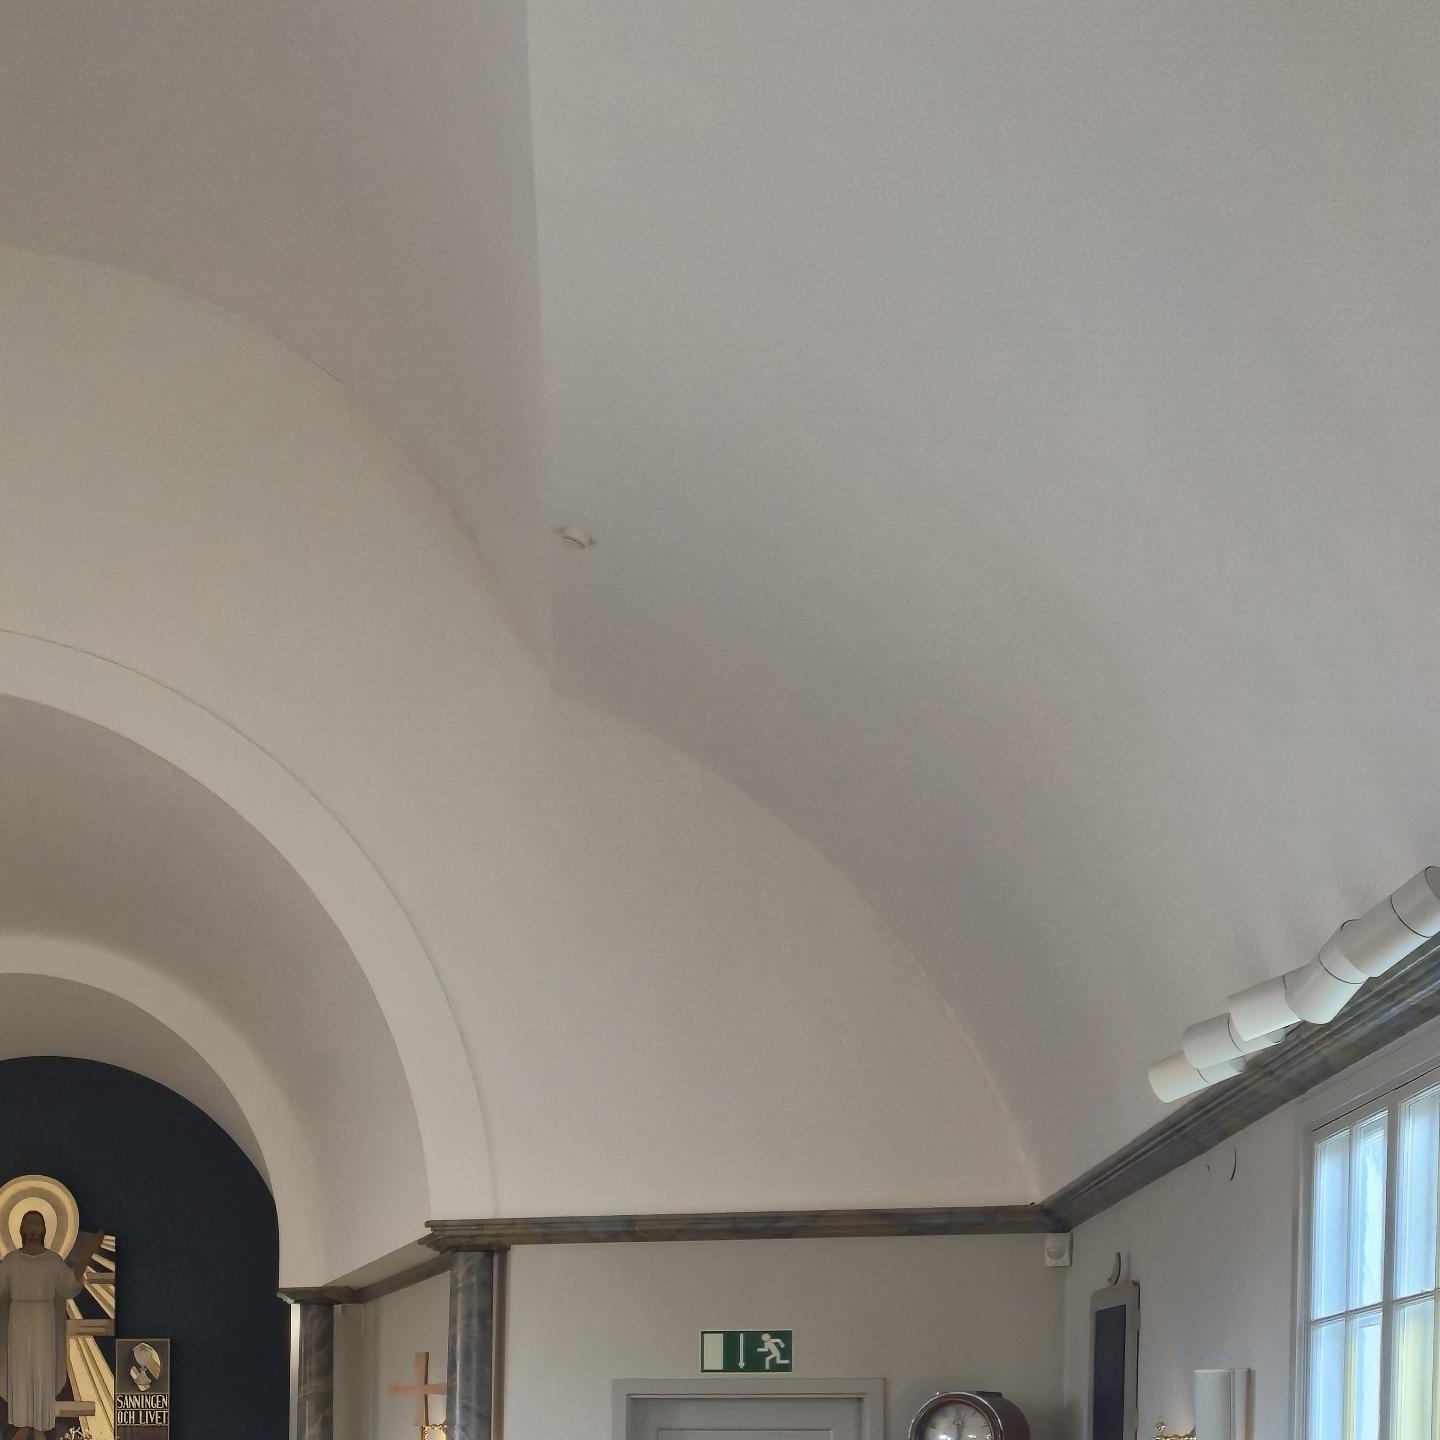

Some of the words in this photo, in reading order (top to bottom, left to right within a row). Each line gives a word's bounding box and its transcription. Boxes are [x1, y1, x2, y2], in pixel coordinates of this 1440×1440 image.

[116, 1394, 168, 1409] SANNINGEN
[117, 1410, 135, 1424] OCH
[140, 1410, 168, 1424] LIVET
